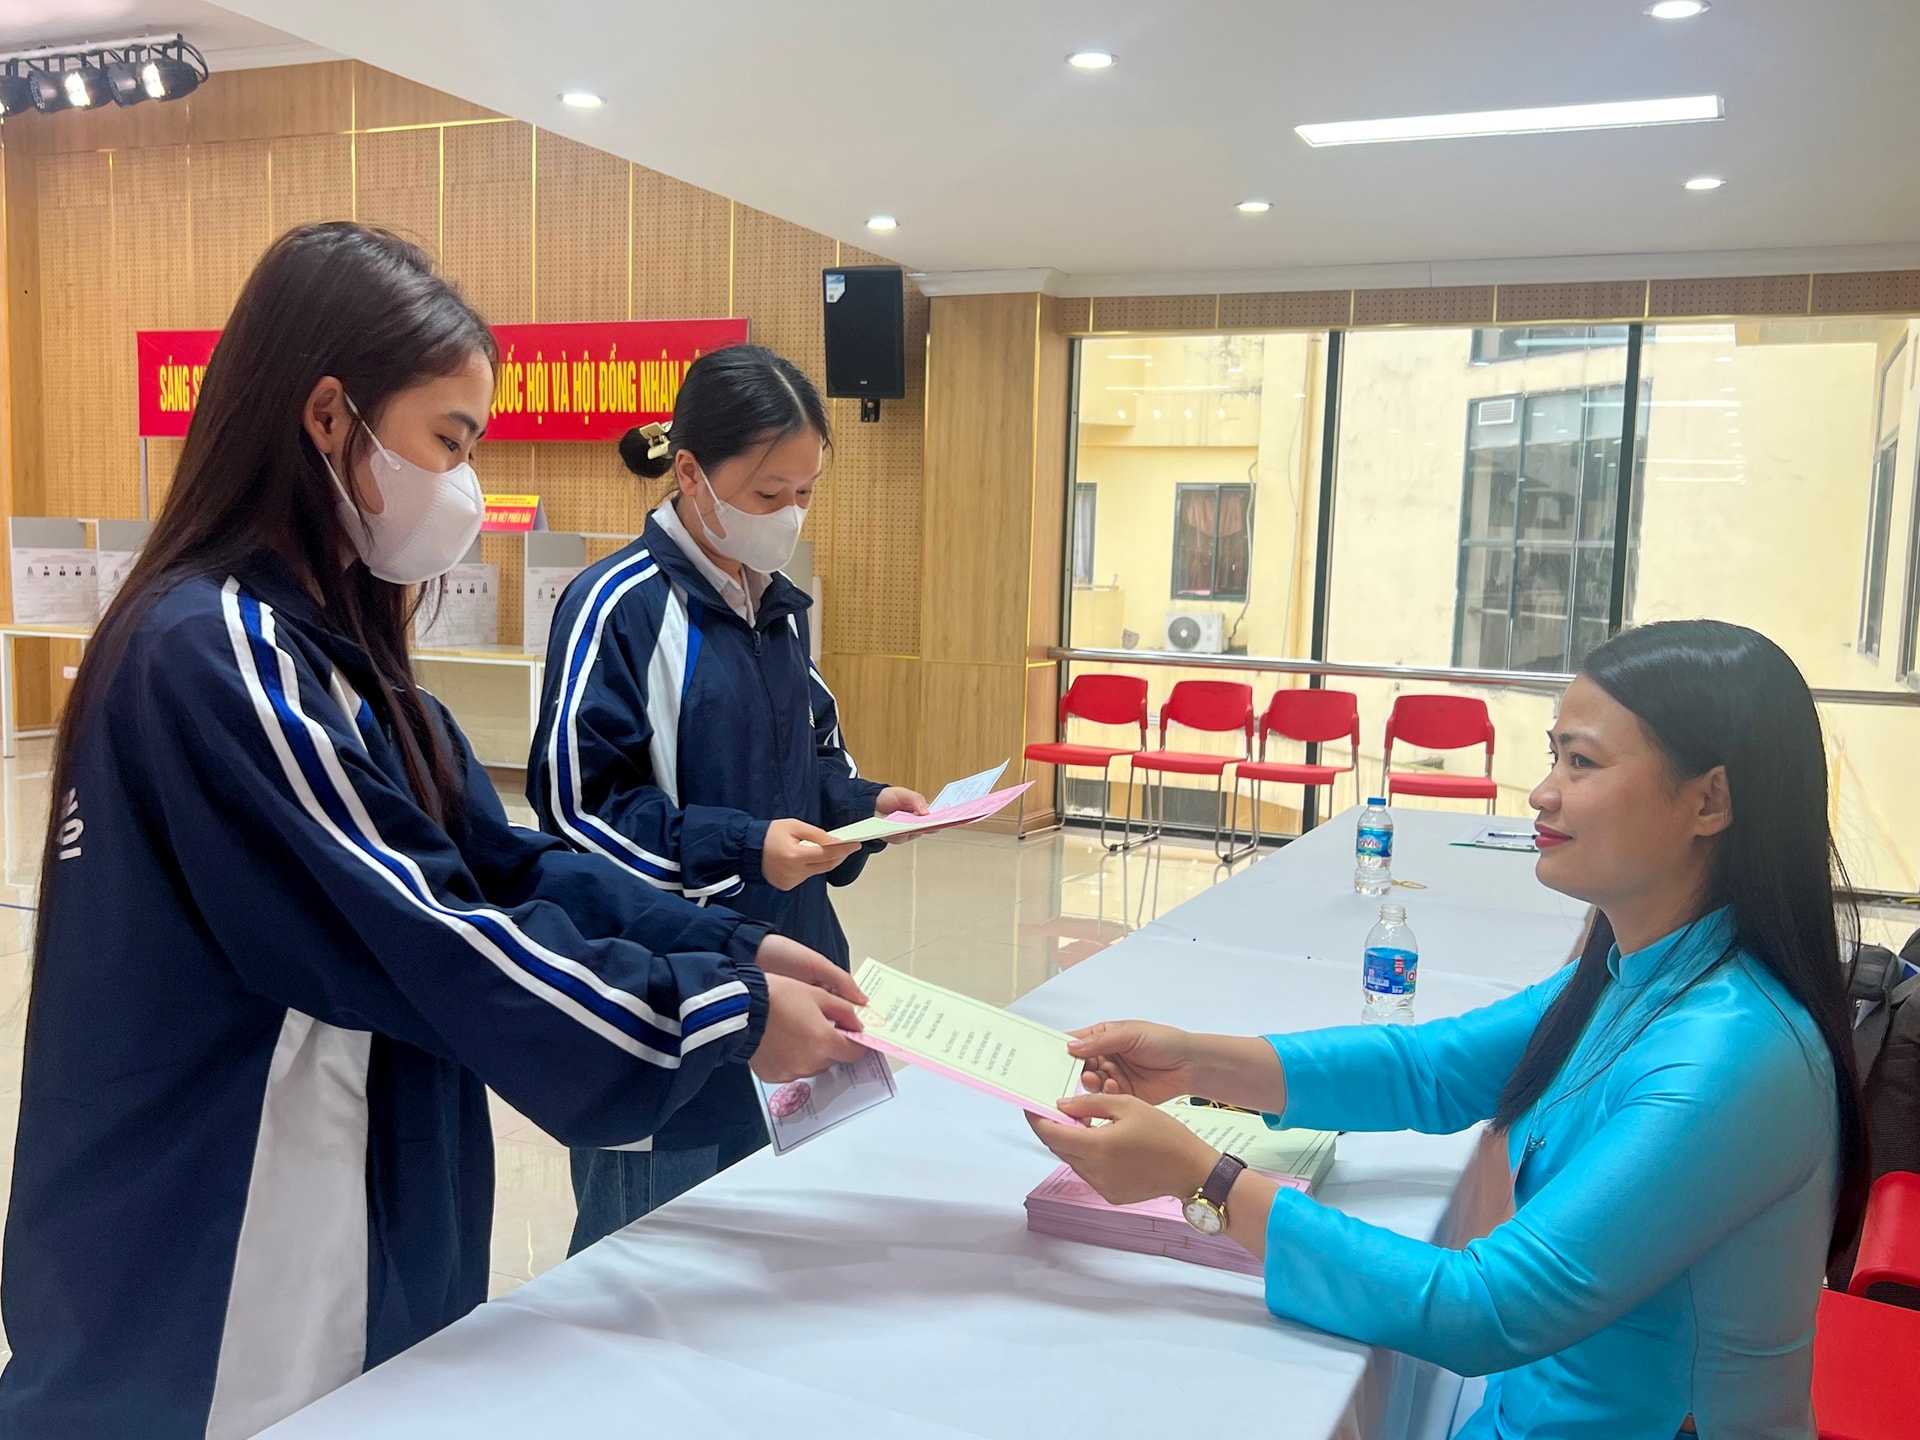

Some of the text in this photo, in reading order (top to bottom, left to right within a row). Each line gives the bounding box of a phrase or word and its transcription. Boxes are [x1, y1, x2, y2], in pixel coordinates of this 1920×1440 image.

[160, 354, 190, 412] SÁNG
[526, 350, 548, 425] HỘI
[551, 350, 570, 413] VÀ
[573, 350, 595, 425] HỘI
[599, 343, 636, 413] ĐỒNG
[640, 349, 679, 413] NHÂN
